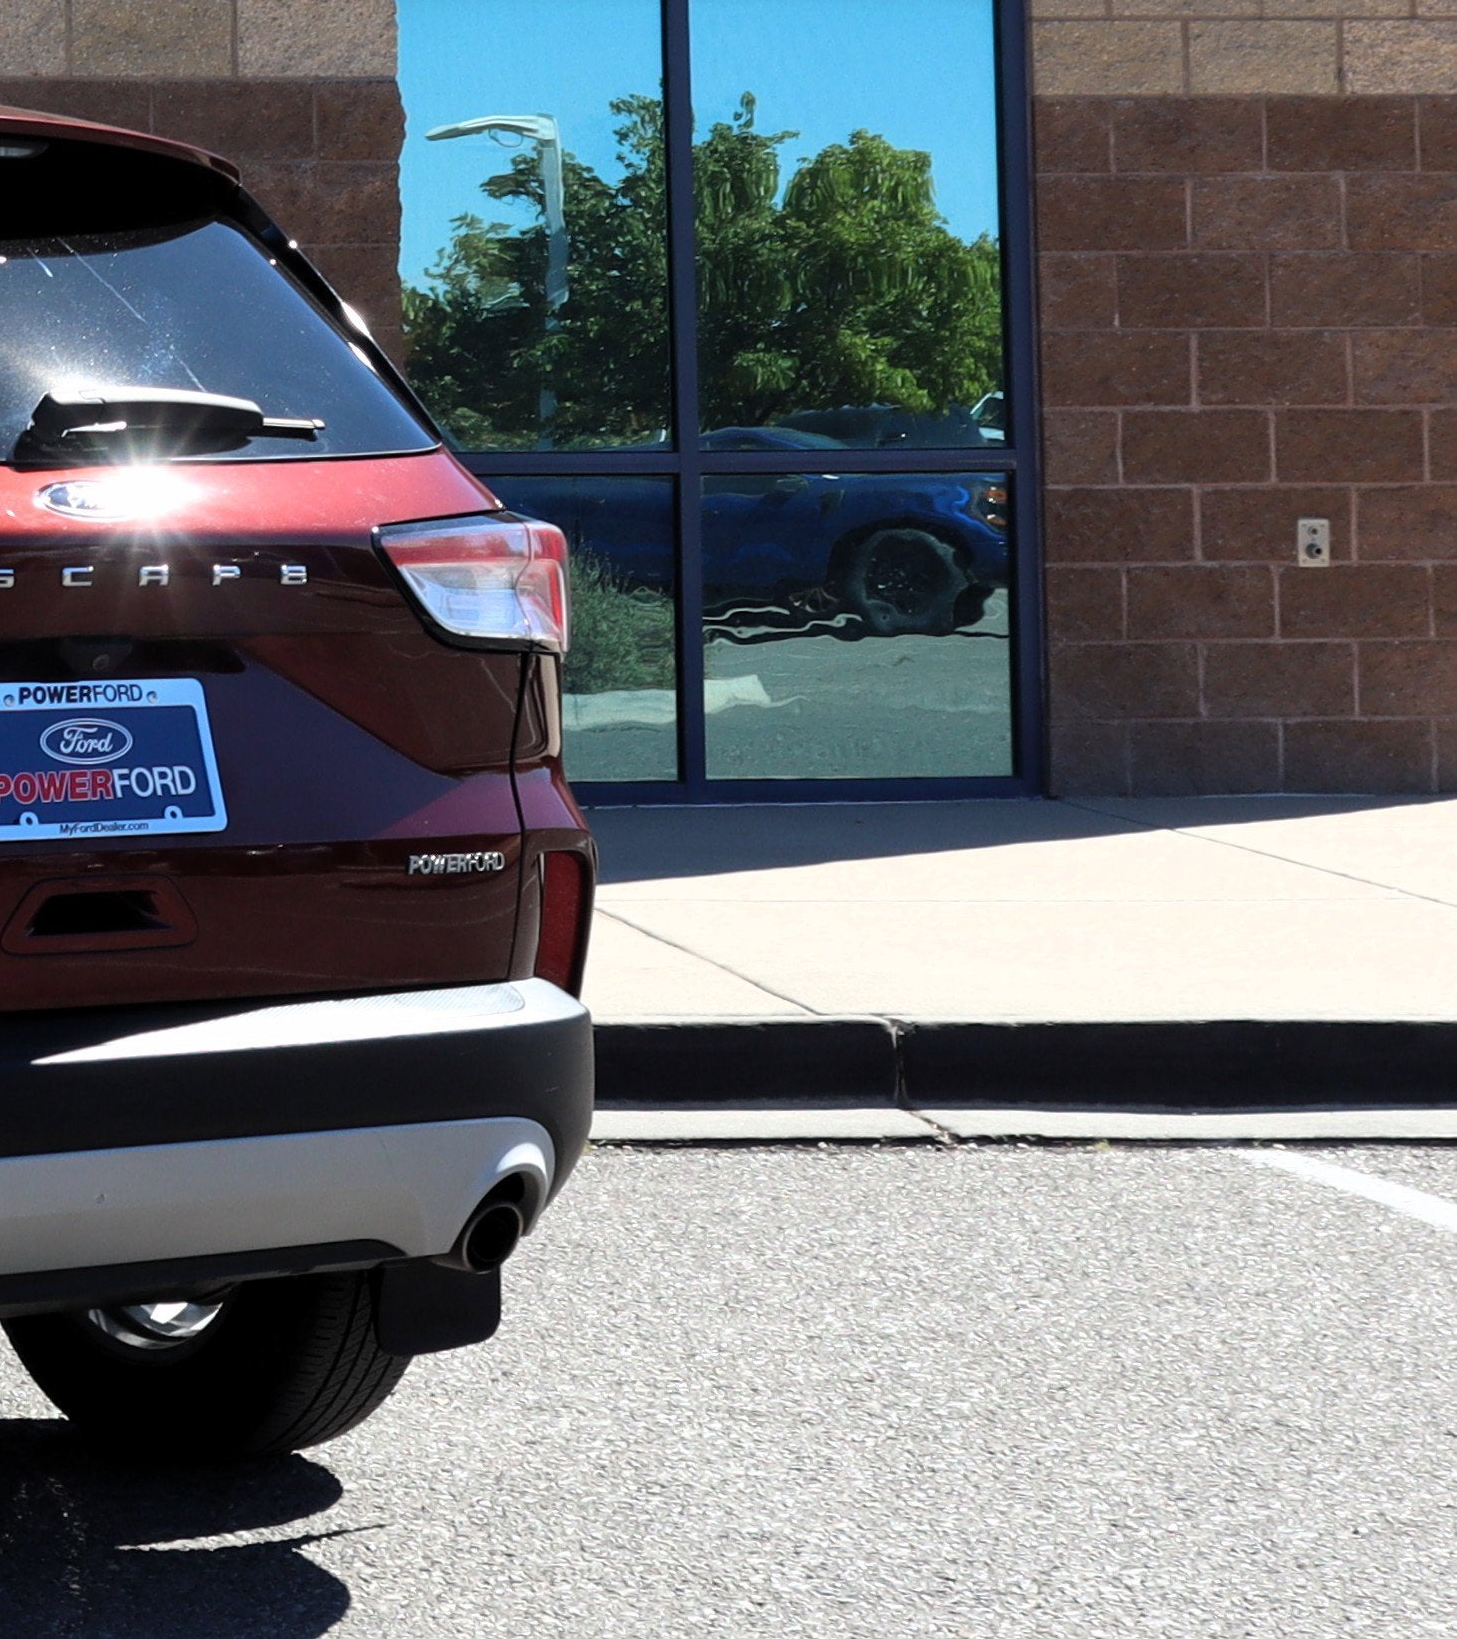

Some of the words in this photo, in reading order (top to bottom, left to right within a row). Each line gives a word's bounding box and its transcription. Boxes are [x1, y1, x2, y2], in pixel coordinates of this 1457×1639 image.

[18, 683, 143, 705] POWERFORD
[59, 726, 114, 754] Ford
[59, 821, 149, 834] MyFordDealer.com
